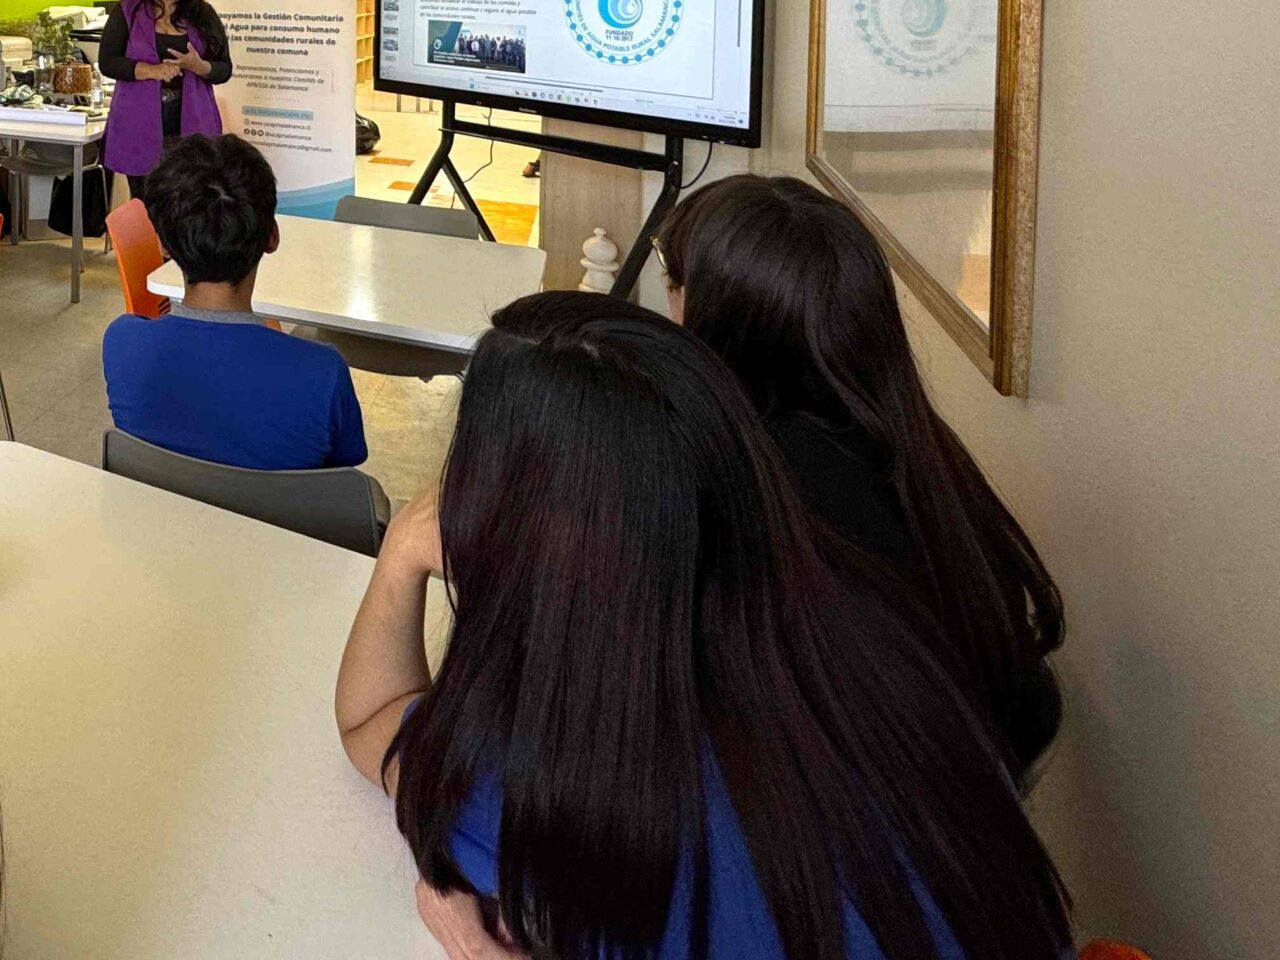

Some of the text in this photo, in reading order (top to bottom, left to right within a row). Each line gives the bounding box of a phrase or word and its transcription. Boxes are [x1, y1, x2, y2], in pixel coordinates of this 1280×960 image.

[263, 12, 291, 20] Gestión
[294, 13, 343, 22] Comunitaria
[307, 26, 340, 34] humano
[296, 37, 323, 45] rurales
[587, 31, 602, 45] AGUA
[277, 48, 308, 56] comuna
